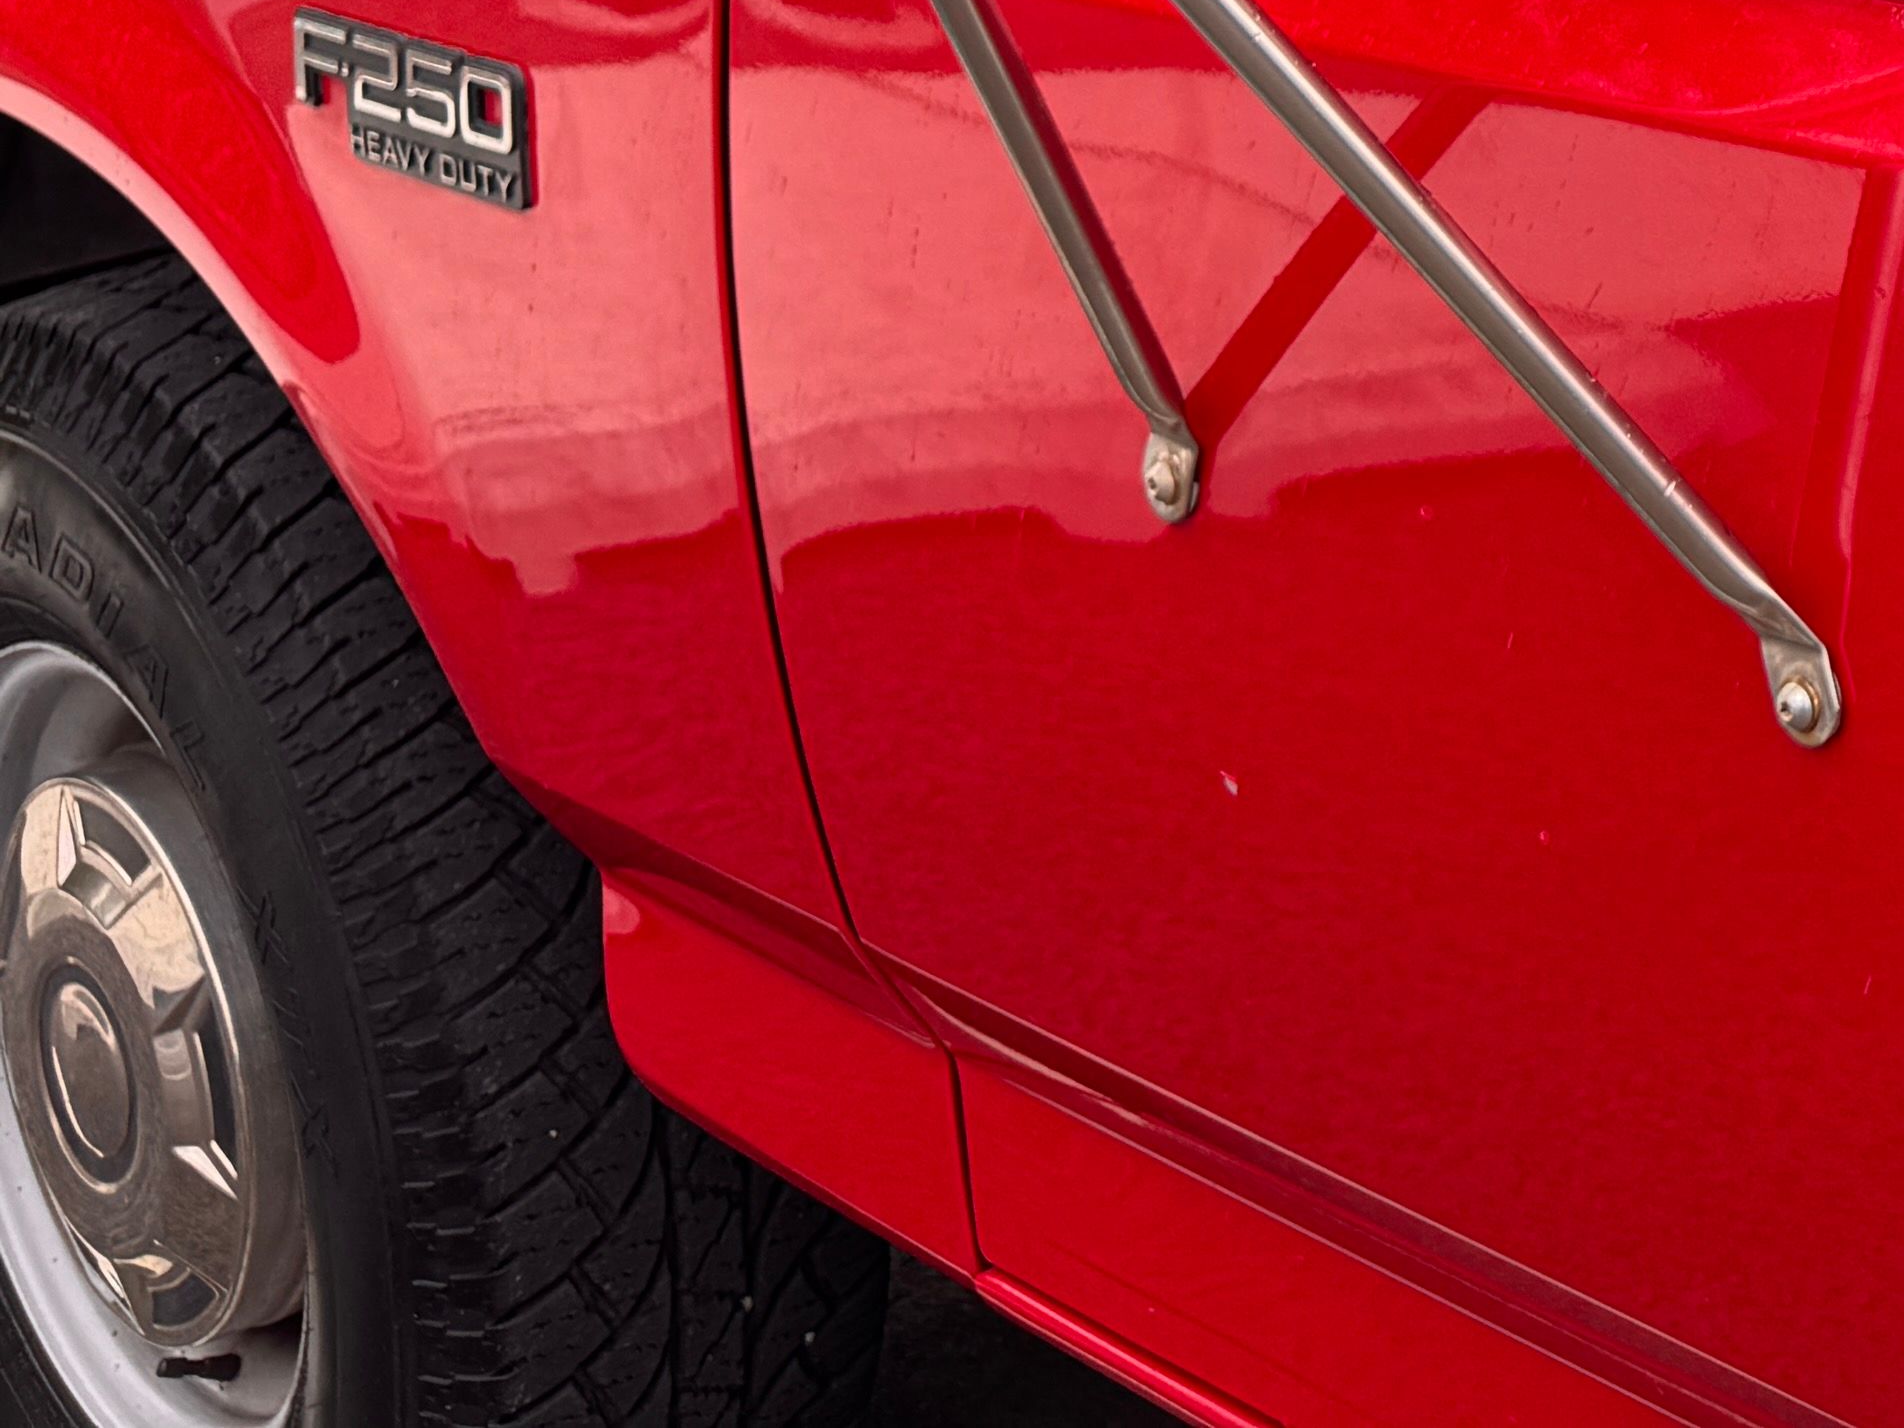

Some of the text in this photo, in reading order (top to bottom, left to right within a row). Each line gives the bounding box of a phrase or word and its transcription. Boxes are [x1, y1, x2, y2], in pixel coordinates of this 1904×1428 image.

[351, 123, 517, 202] HEAVY DUTY
[0, 505, 206, 792] ADIAL
